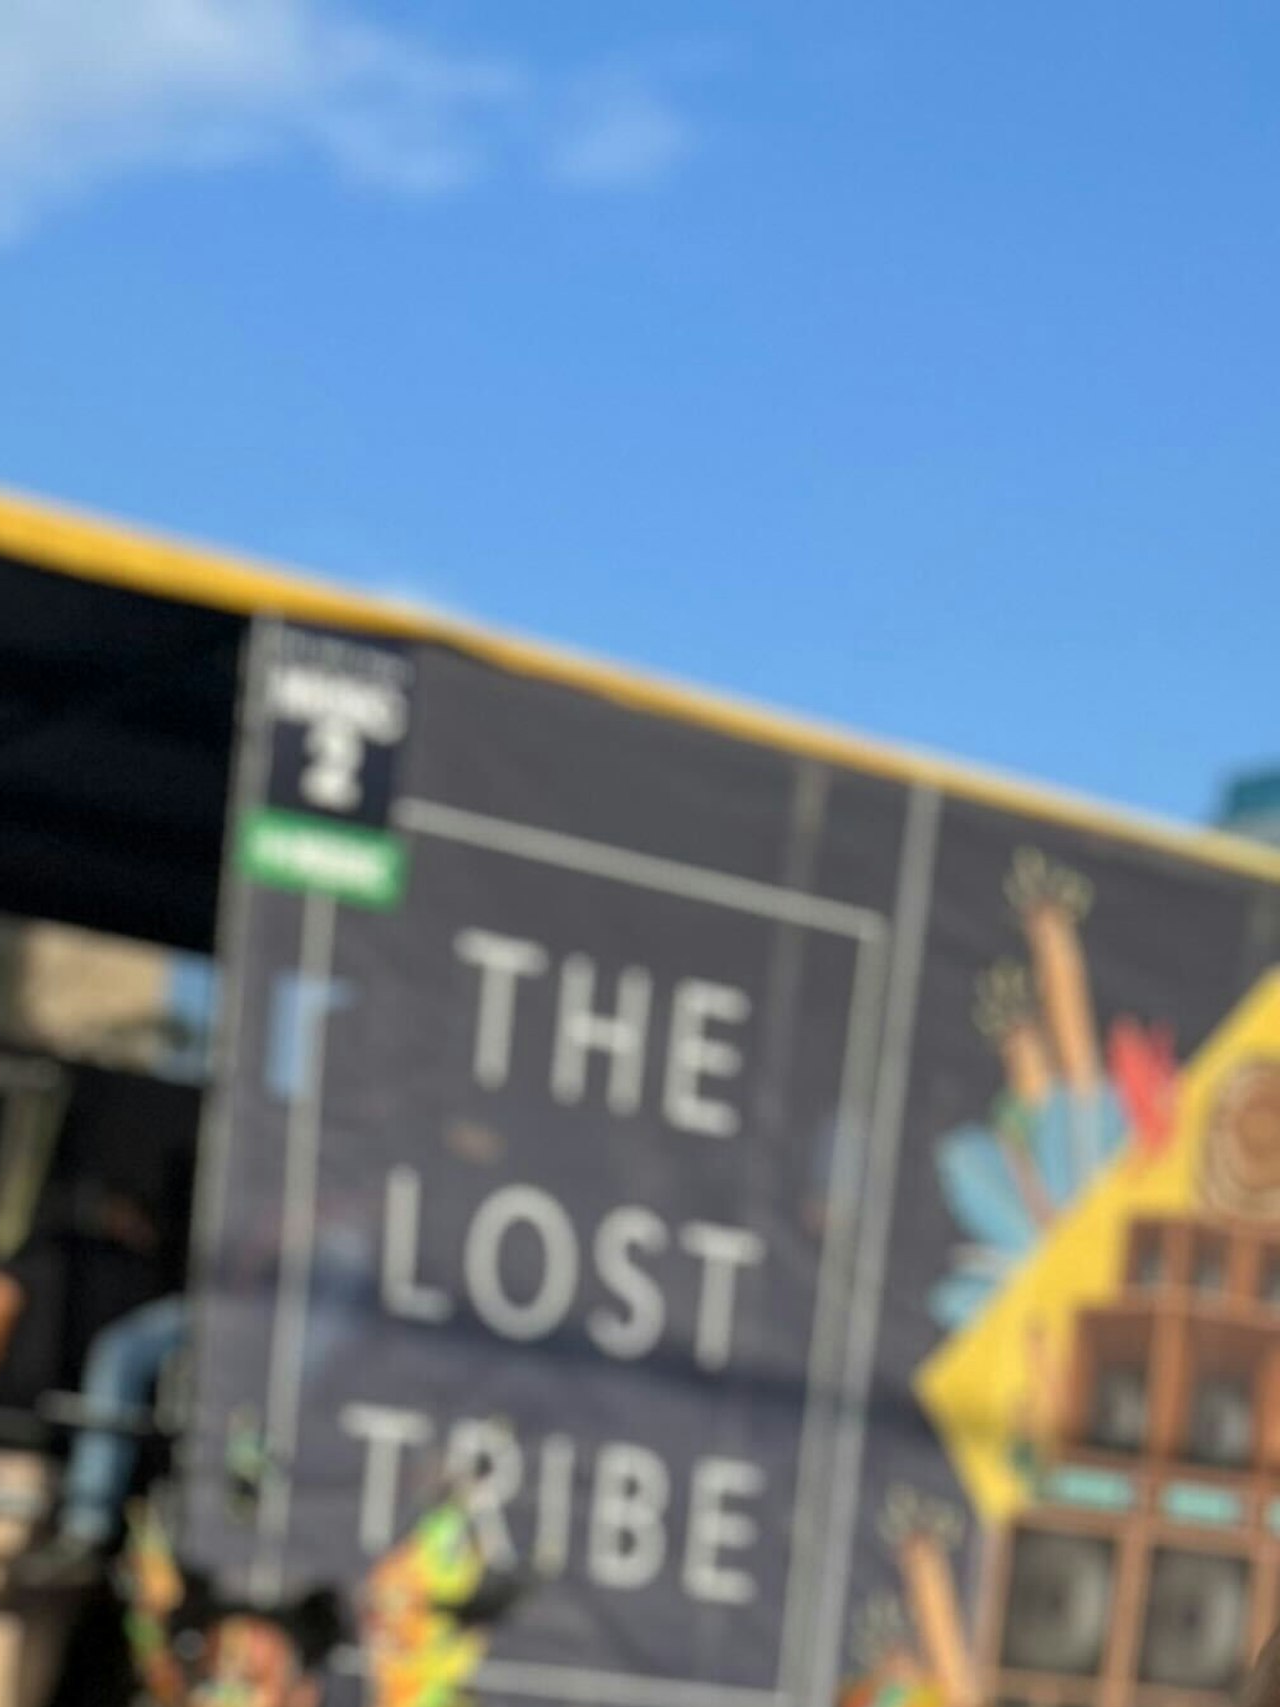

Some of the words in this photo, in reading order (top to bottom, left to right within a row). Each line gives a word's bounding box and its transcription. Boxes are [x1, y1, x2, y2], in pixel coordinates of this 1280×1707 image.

[452, 926, 752, 1139] THE
[380, 1164, 766, 1374] LOST
[340, 1402, 768, 1606] TRIBE
